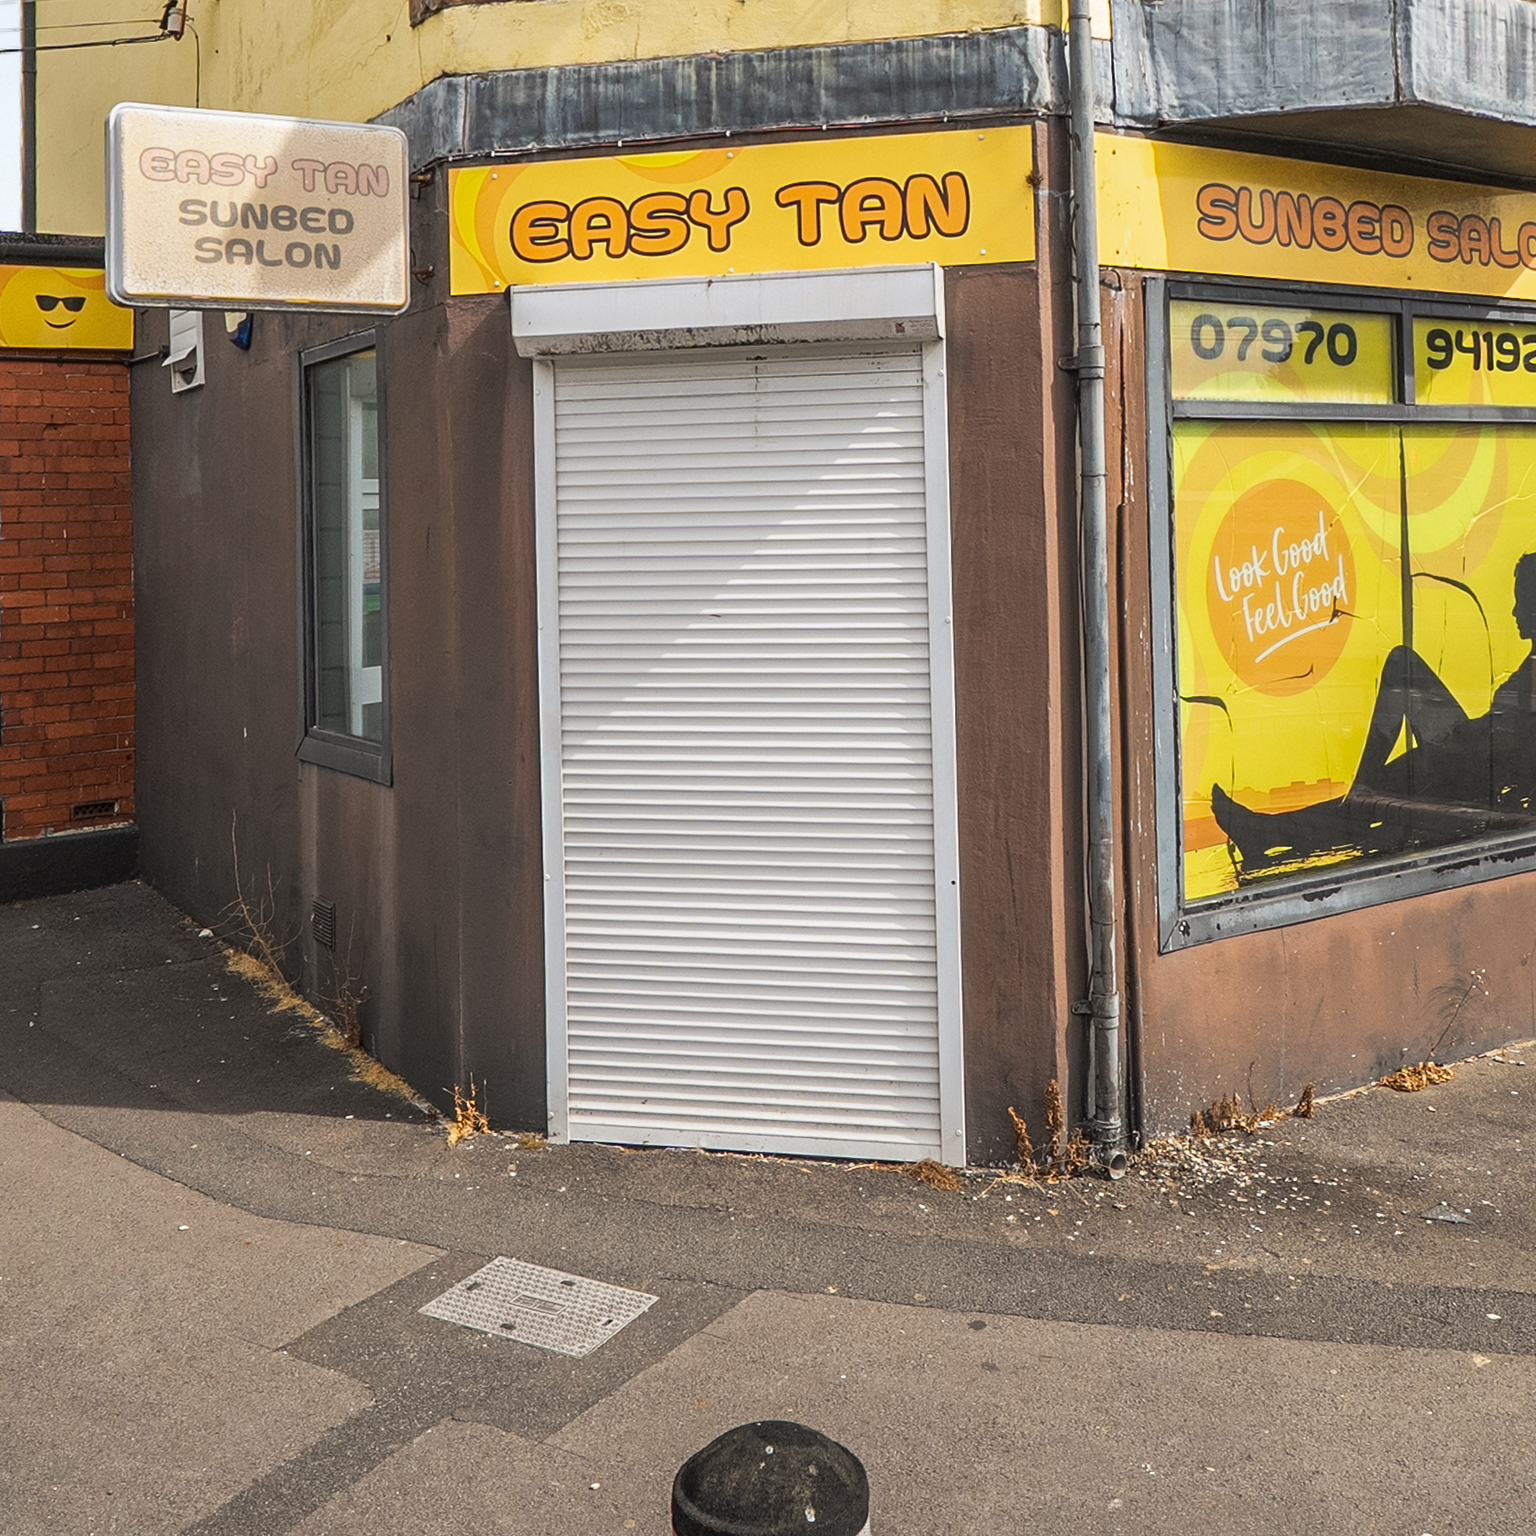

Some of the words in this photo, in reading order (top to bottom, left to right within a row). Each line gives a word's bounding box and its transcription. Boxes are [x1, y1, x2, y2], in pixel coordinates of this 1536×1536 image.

[138, 145, 278, 189] EASY
[291, 156, 390, 198] TAN
[178, 198, 355, 235] SUNBED
[509, 186, 750, 262] EASY
[776, 170, 971, 246] TAN
[1196, 182, 1414, 258] SUNBED
[194, 236, 343, 271] SALON
[1190, 313, 1357, 366] 07970
[1214, 545, 1271, 602] Look
[1272, 510, 1329, 576] Good
[1243, 580, 1292, 643] Feel
[1292, 553, 1349, 620] Good
